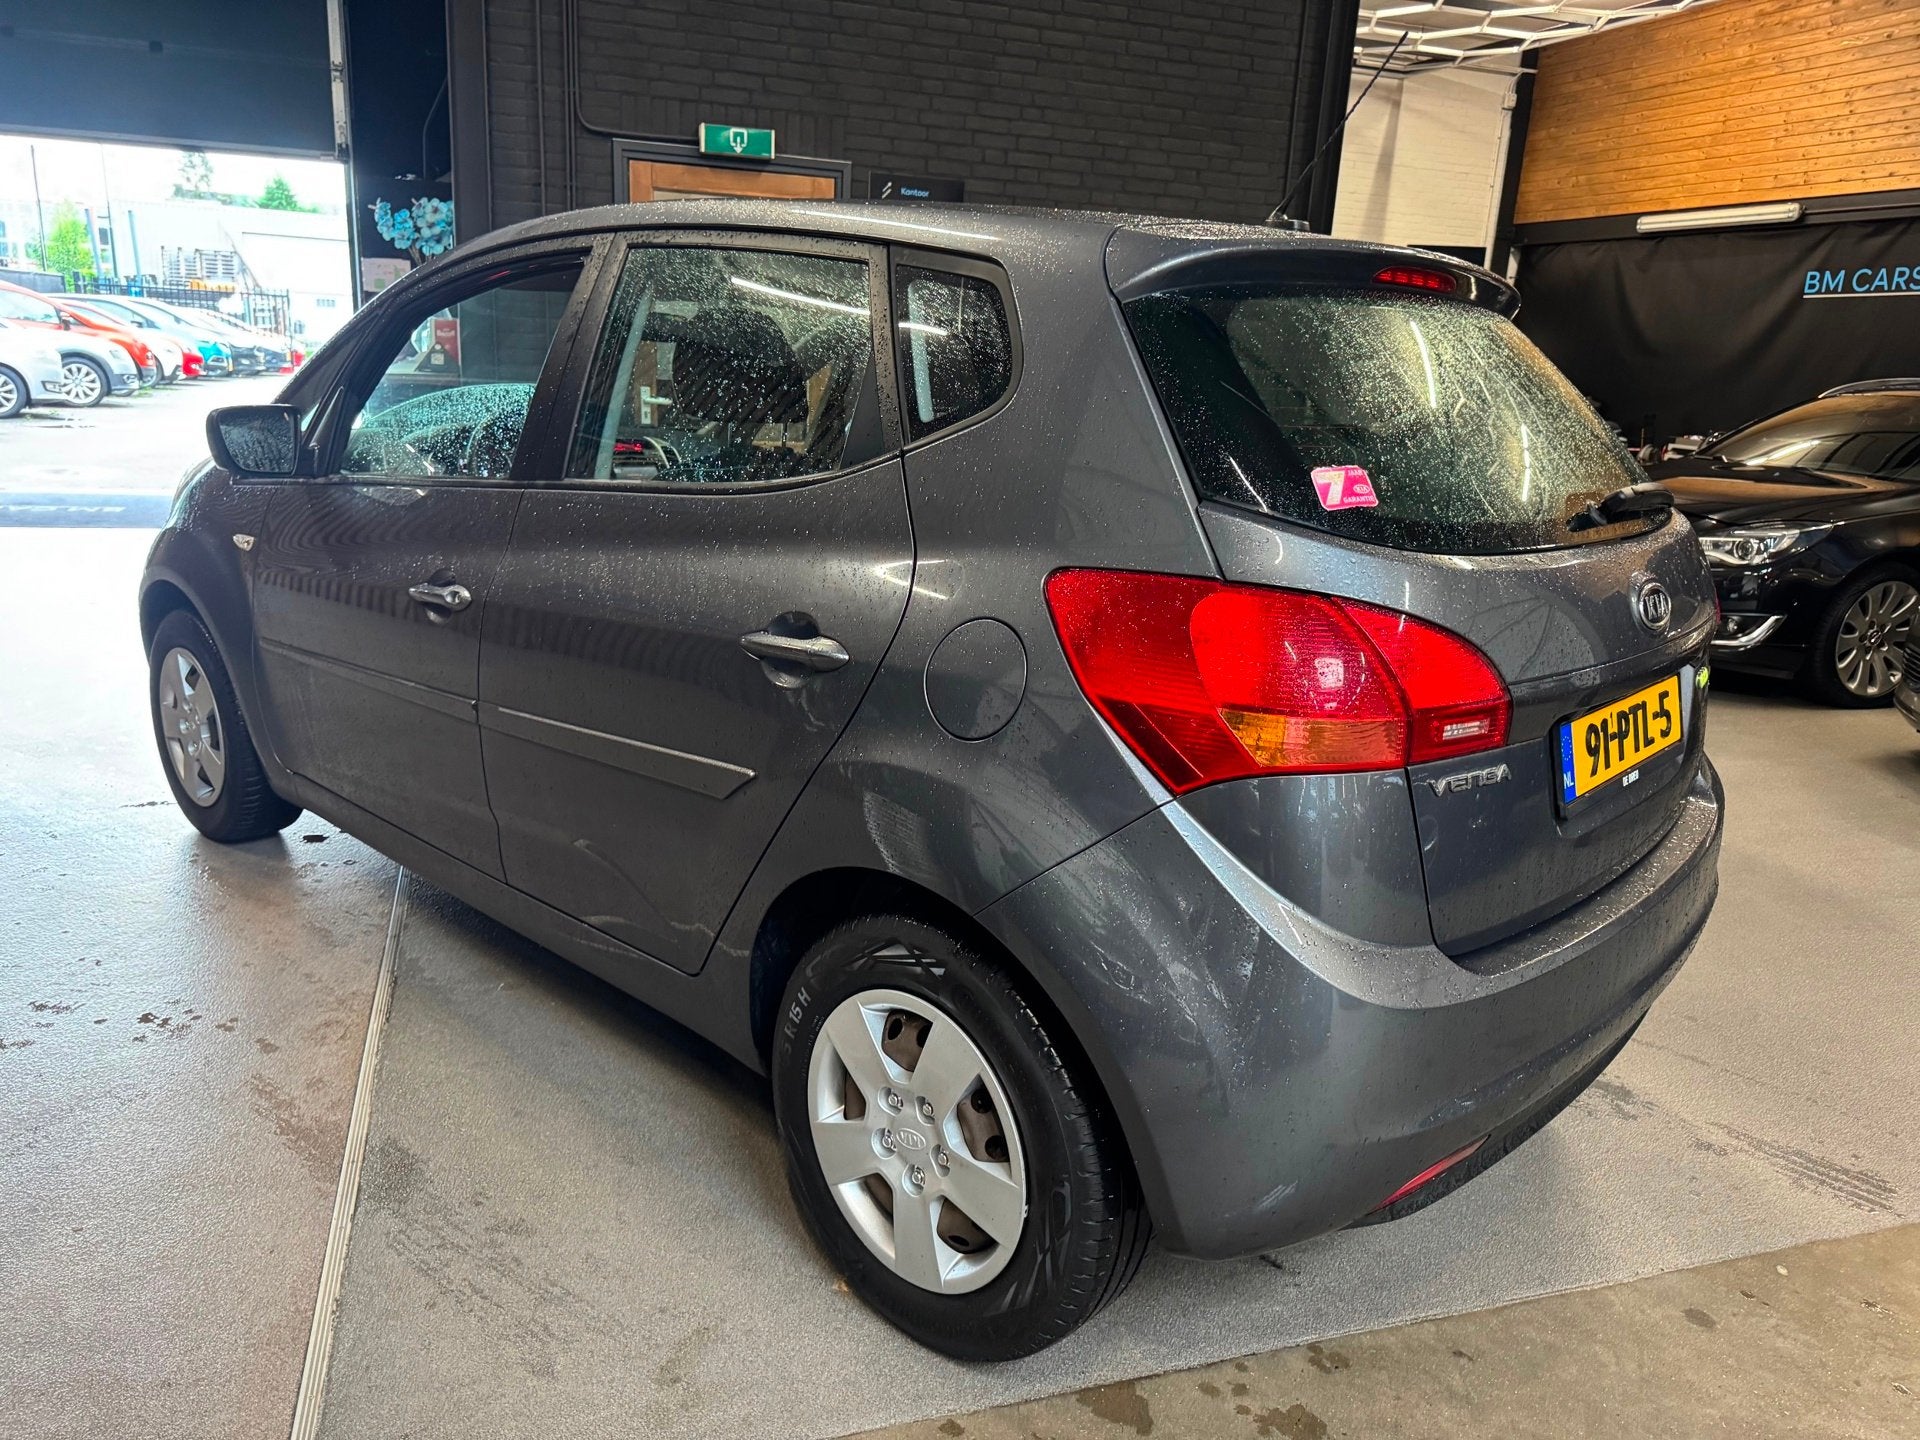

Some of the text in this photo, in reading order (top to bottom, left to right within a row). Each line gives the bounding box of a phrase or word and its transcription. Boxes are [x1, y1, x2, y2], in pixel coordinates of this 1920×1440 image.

[1804, 266, 1920, 293] BM CARS
[1314, 470, 1345, 505] 7
[1645, 592, 1669, 620] KIA
[1585, 690, 1672, 778] 91-PTL-5
[1426, 763, 1512, 797] VENGA
[1563, 773, 1575, 789] NL
